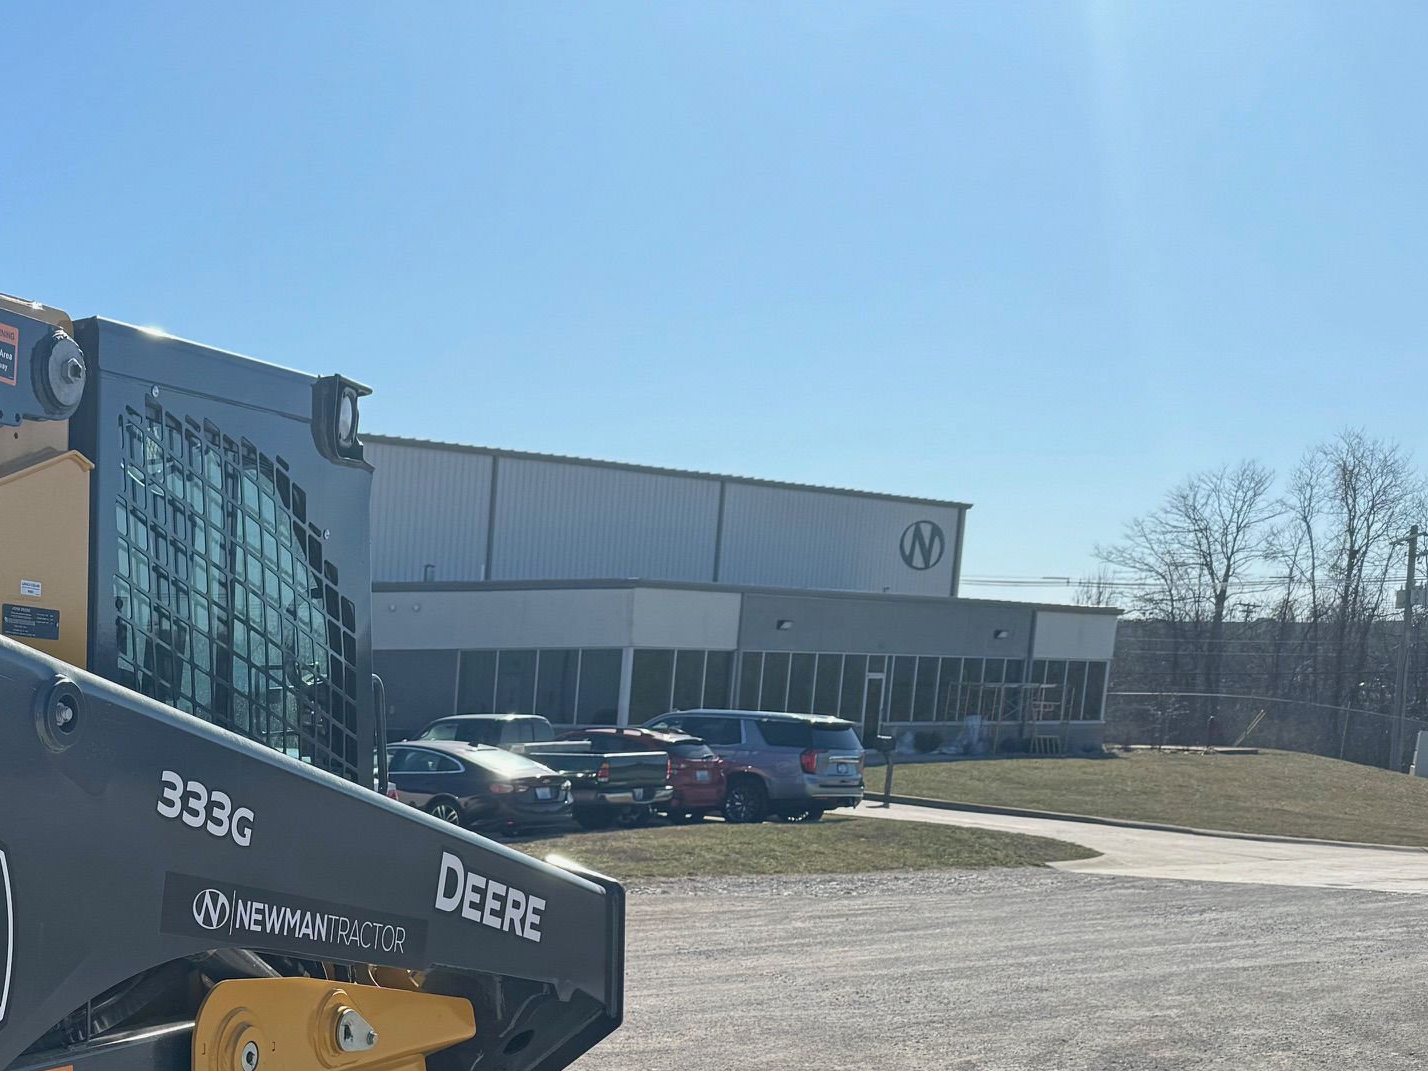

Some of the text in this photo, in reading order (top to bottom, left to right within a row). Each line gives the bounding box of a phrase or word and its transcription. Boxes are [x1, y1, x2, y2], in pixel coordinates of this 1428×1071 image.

[0, 349, 13, 361] Area
[157, 770, 255, 847] 333G
[435, 851, 546, 943] DEERE
